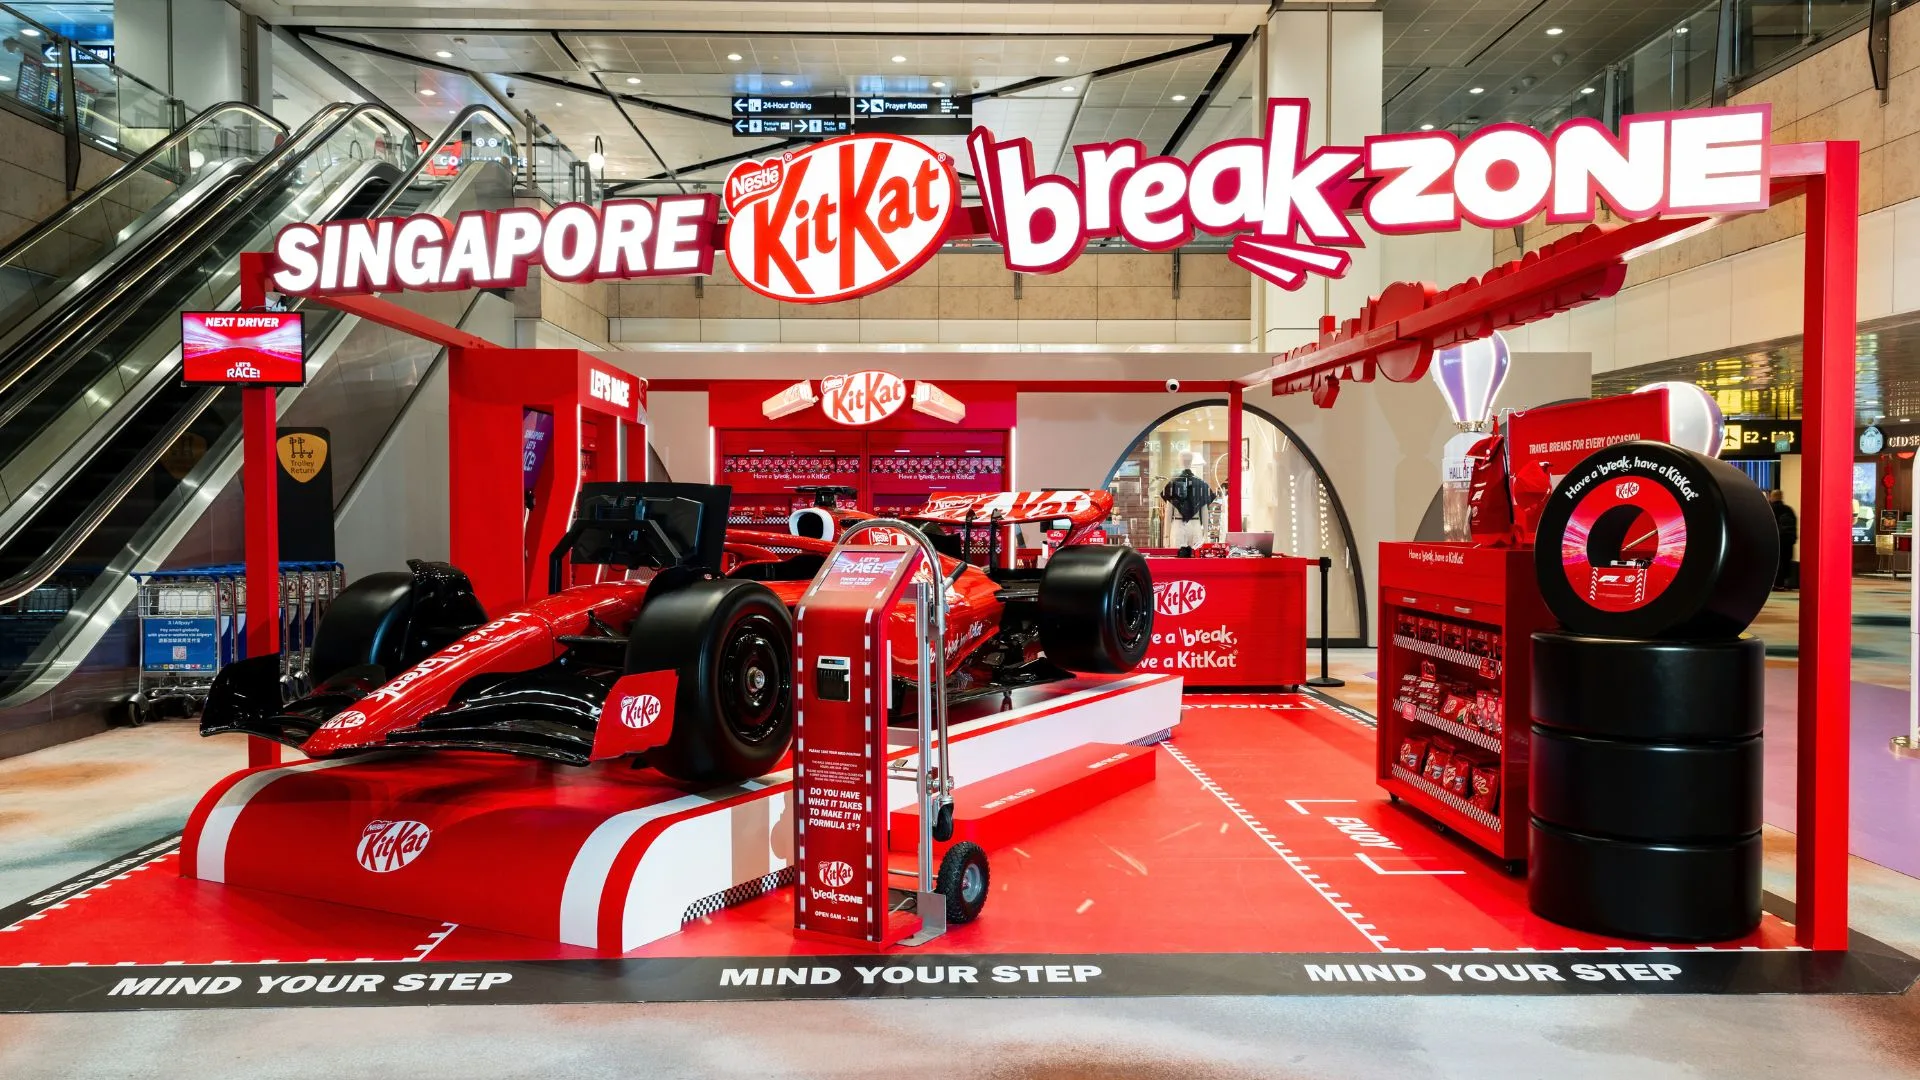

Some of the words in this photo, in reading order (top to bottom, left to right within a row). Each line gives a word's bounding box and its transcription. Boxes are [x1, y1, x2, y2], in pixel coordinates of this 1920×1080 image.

[763, 102, 789, 110] 24-Hour
[790, 102, 812, 111] Dining
[885, 103, 907, 111] Prayer
[273, 199, 704, 293] SINGAPORE
[996, 103, 1352, 269] break
[1364, 111, 1764, 226] ZONE
[205, 317, 235, 327] NEXT
[237, 318, 280, 328] DRIVER
[226, 368, 261, 378] RACE!
[1529, 443, 1548, 455] TRAVEL
[1549, 440, 1572, 452] BREAKS
[1573, 439, 1585, 450] FOR
[1586, 436, 1605, 450] EVERY
[1744, 432, 1760, 444] E2
[291, 460, 315, 468] Trolley
[1565, 475, 1592, 500] Have
[1591, 470, 1599, 480] a
[1598, 456, 1633, 477] break,
[1634, 457, 1659, 472] have
[1659, 465, 1667, 474] a
[841, 563, 887, 574] RACE!
[1157, 581, 1204, 615] KitKat
[465, 612, 532, 642] Have
[1166, 633, 1176, 644] a
[1181, 625, 1238, 648] break,
[448, 644, 465, 654] a
[1163, 657, 1174, 669] a
[625, 696, 660, 728] KitKat
[823, 789, 839, 797] YOU
[840, 791, 861, 800] HAVE
[808, 798, 830, 807] WHAT
[839, 801, 863, 810] TAKES
[809, 818, 845, 829] FORMULA
[810, 808, 820, 816] TO
[821, 809, 843, 818] MAKE
[853, 813, 861, 821] IN
[1323, 816, 1403, 851] ENJOY
[360, 822, 429, 872] KitKat
[823, 862, 852, 887] KitKat
[810, 887, 838, 902] break
[838, 894, 863, 905] ZONE
[720, 968, 841, 986] MIND
[854, 966, 979, 984] YOUR
[991, 966, 1102, 983] STEP
[1304, 965, 1427, 982] MIND
[1432, 964, 1567, 982] YOUR
[1570, 964, 1683, 981] STEP
[107, 974, 242, 996] MIND
[256, 975, 385, 994] YOUR
[393, 973, 513, 992] STEP
